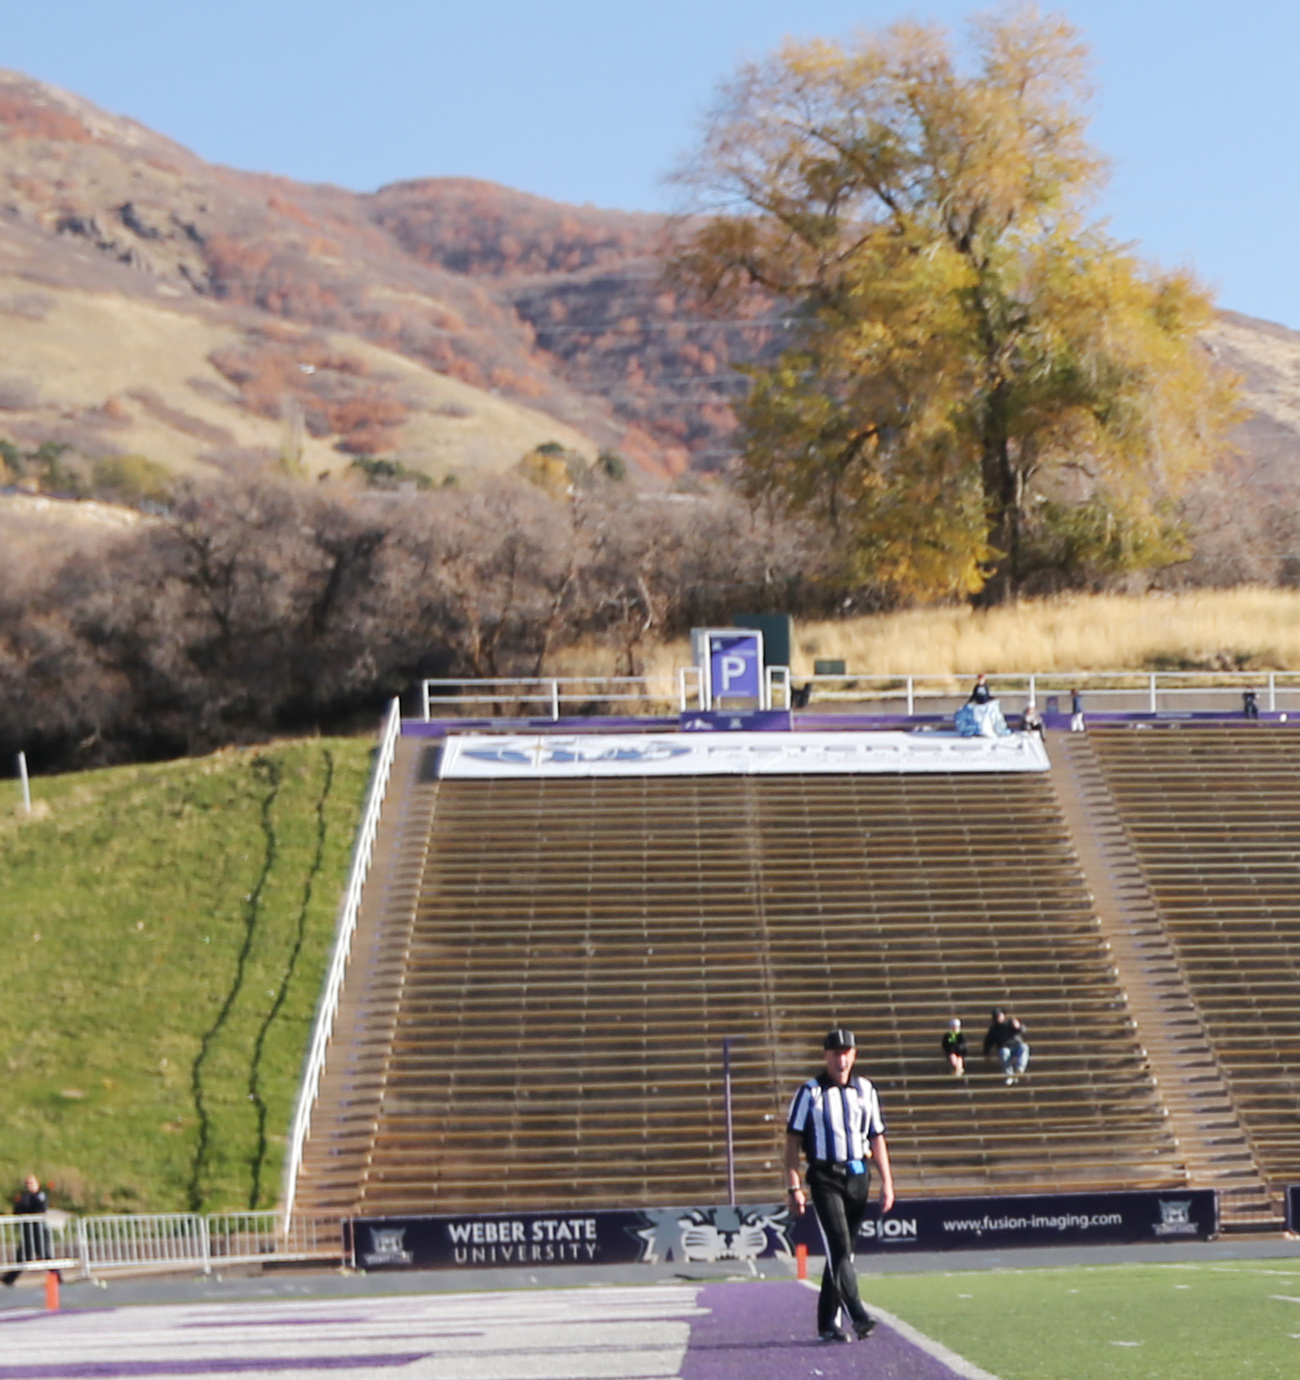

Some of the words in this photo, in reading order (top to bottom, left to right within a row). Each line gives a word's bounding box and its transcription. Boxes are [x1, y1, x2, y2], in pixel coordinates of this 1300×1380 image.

[721, 656, 746, 691] P
[449, 1221, 525, 1244] WEBER
[532, 1219, 597, 1241] STATE
[858, 1218, 918, 1239] SION
[943, 1211, 1122, 1232] www.fusion-imaging.com
[454, 1242, 597, 1264] UNIVERSITY
